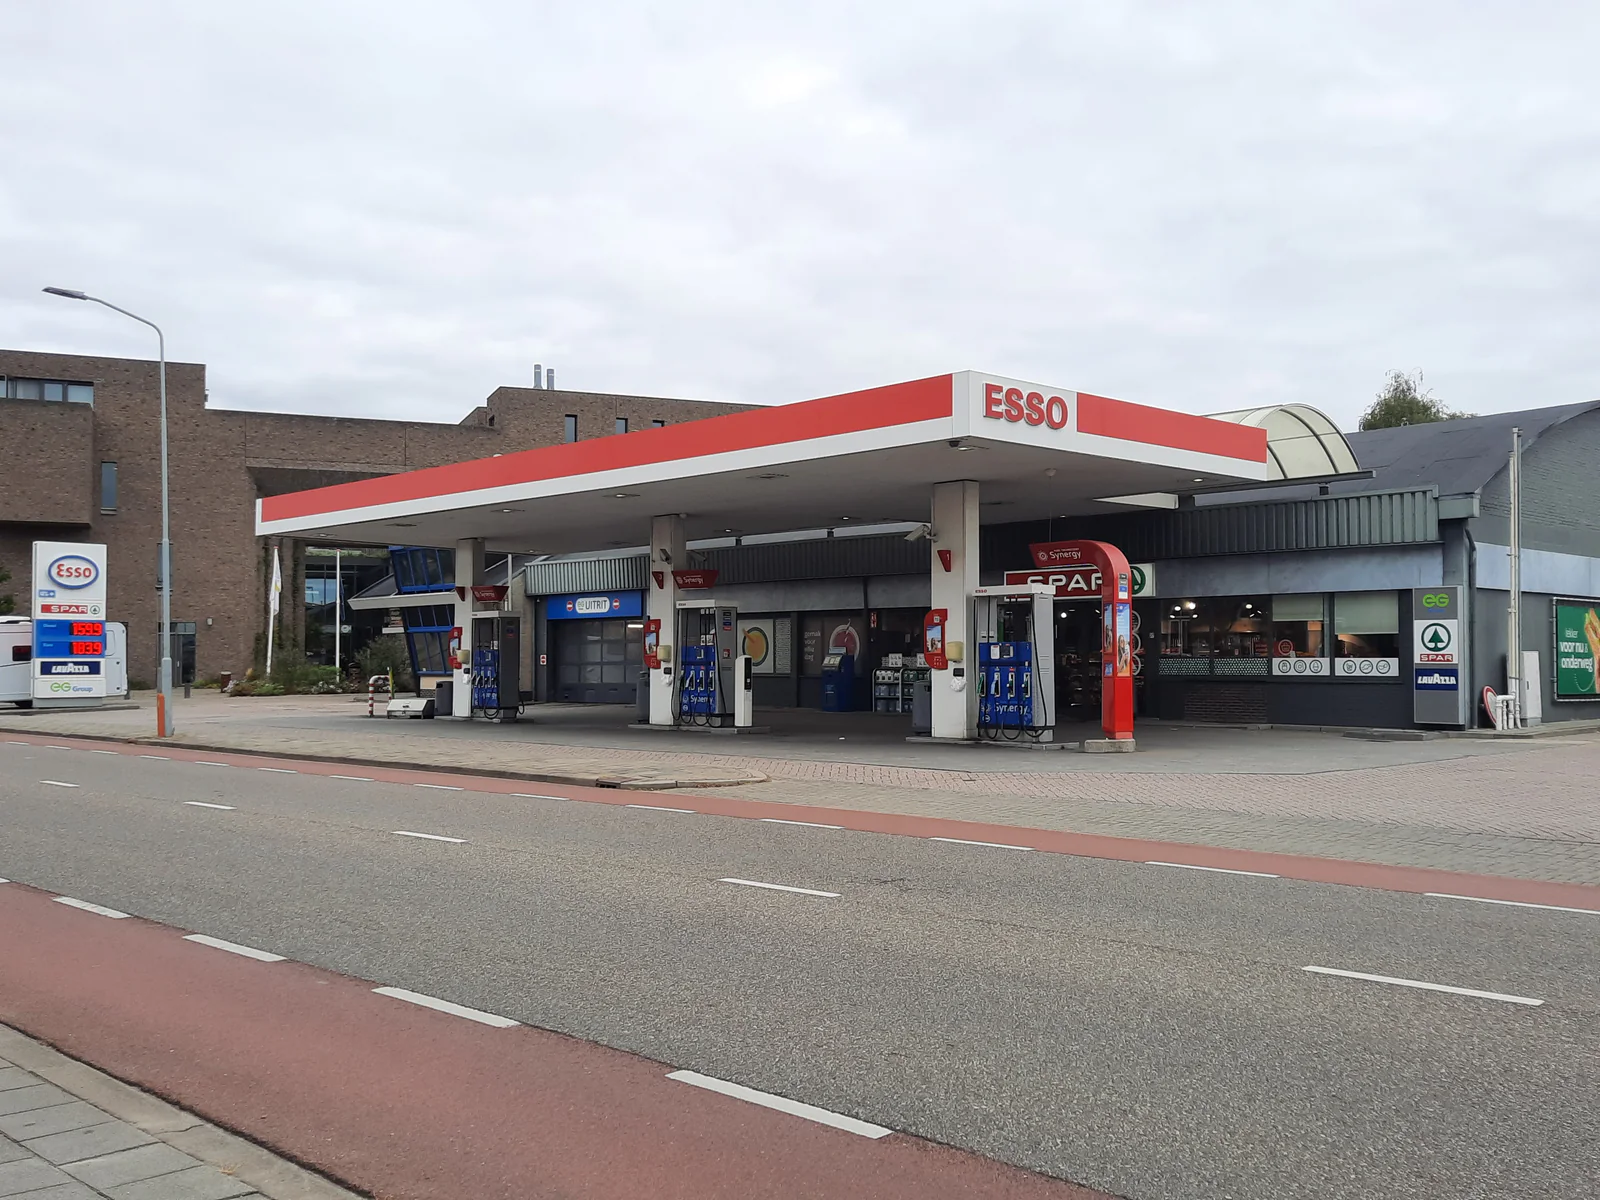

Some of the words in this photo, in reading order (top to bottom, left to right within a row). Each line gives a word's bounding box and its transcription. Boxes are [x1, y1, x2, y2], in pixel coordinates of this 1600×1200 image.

[983, 382, 1068, 430] ESSO
[1049, 551, 1081, 560] Synergy
[56, 563, 92, 578] Esso
[51, 605, 88, 613] SPAR
[585, 600, 608, 610] UITRIT
[1559, 641, 1575, 653] voor
[1575, 642, 1584, 653] nu
[1561, 655, 1594, 672] onderweg
[1417, 673, 1457, 685] LAVAZZA
